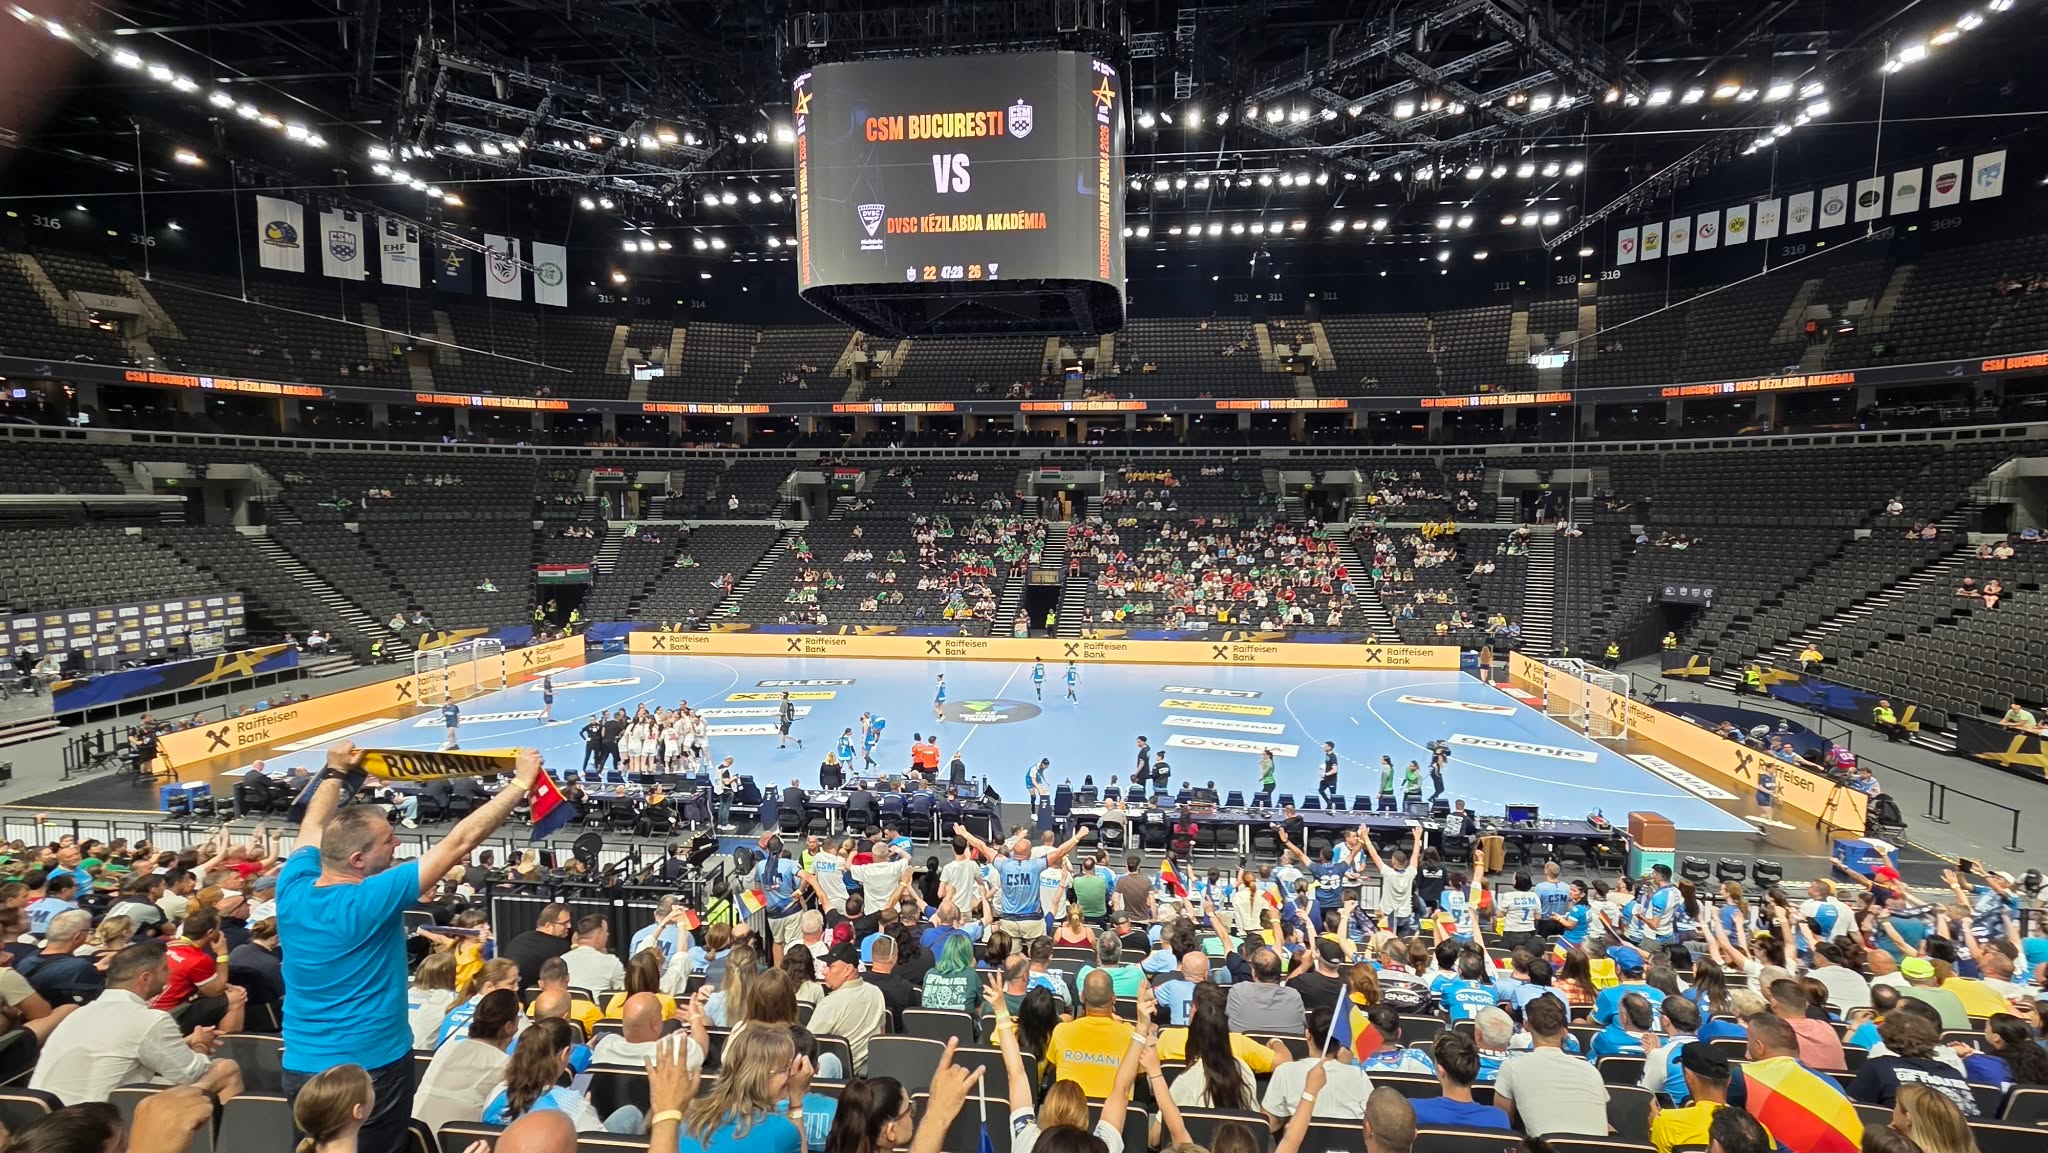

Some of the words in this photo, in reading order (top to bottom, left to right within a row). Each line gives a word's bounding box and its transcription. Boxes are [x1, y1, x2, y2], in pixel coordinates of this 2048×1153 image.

[866, 116, 904, 142] CSM
[908, 111, 1004, 140] BUCURESTI
[1099, 123, 1110, 153] 2026
[799, 134, 807, 161] 2026
[932, 153, 971, 193] VS
[1099, 182, 1110, 204] EHF
[1099, 200, 1110, 230] BANK
[32, 214, 62, 231] 316
[887, 217, 919, 234] DVSC
[920, 213, 984, 233] KÉZILABDA
[986, 210, 1047, 231] AKADÉMIA
[1930, 216, 1963, 232] 309
[131, 232, 157, 247] 316
[330, 231, 355, 244] CSM
[384, 243, 406, 252] EHF
[1099, 227, 1110, 279] RAIFFEISEN
[1781, 243, 1807, 257] 310
[923, 265, 937, 280] 22
[968, 264, 982, 279] 26
[1600, 269, 1621, 282] 310
[1494, 281, 1511, 291] 311
[1556, 274, 1577, 286] 310
[598, 293, 616, 304] 315
[1268, 292, 1284, 302] 311
[1982, 358, 2005, 372] CSM
[1661, 387, 1680, 397] CSM
[1722, 382, 1735, 393] VS
[670, 634, 710, 645] Raiffeisen
[805, 637, 847, 647] Raiffeisen
[945, 640, 988, 649] Raiffeisen
[670, 643, 690, 652] Bank
[805, 646, 827, 654] Bank
[945, 648, 967, 656] Bank
[1083, 642, 1127, 651] Raiffeisen
[1232, 645, 1278, 654] Raiffeisen
[1386, 647, 1434, 657] Raiffeisen
[1083, 650, 1106, 659] Bank
[1232, 653, 1255, 662] Bank
[1386, 656, 1410, 665] Bank
[760, 680, 851, 688] SELECT
[1163, 685, 1259, 699] SELECT
[237, 710, 299, 733] Raiffeisen
[237, 729, 270, 746] Bank
[1460, 737, 1585, 758] gorenje
[381, 753, 503, 778] ROMANIA
[1640, 756, 1724, 797] VALAMAR
[816, 860, 836, 871] CSM
[1006, 872, 1031, 886] CSM
[1040, 876, 1060, 887] CSM
[1514, 897, 1537, 906] CSM
[1548, 893, 1568, 904] CSM
[1522, 907, 1530, 922] 7
